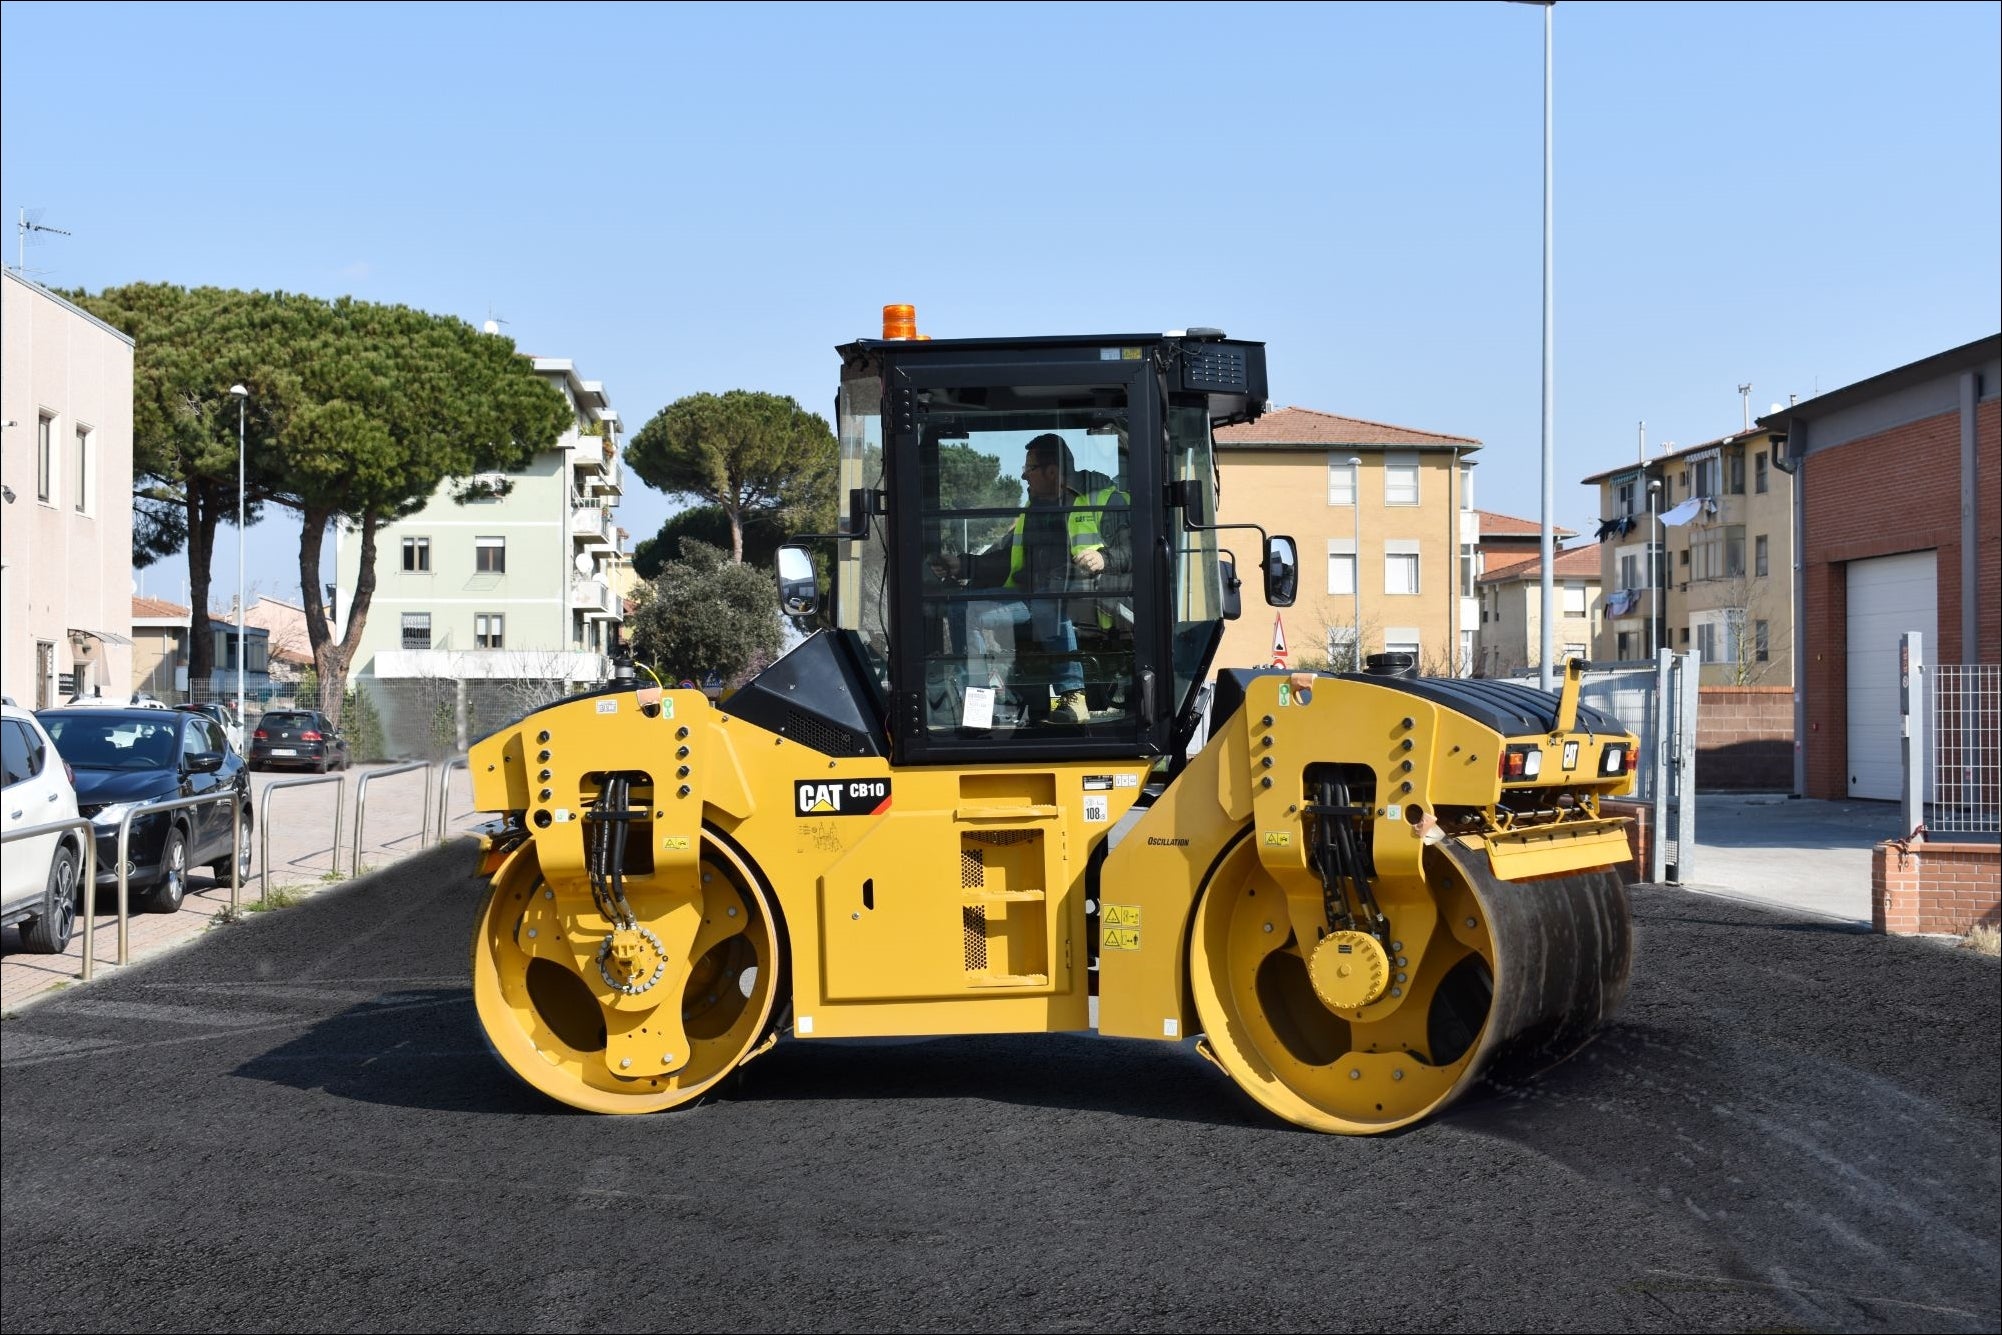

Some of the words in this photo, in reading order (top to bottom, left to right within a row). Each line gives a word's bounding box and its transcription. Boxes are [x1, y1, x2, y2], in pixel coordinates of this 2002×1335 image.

[1564, 744, 1578, 768] CAT
[799, 784, 843, 812] CAT
[849, 783, 884, 798] CB10
[1086, 807, 1100, 820] 108
